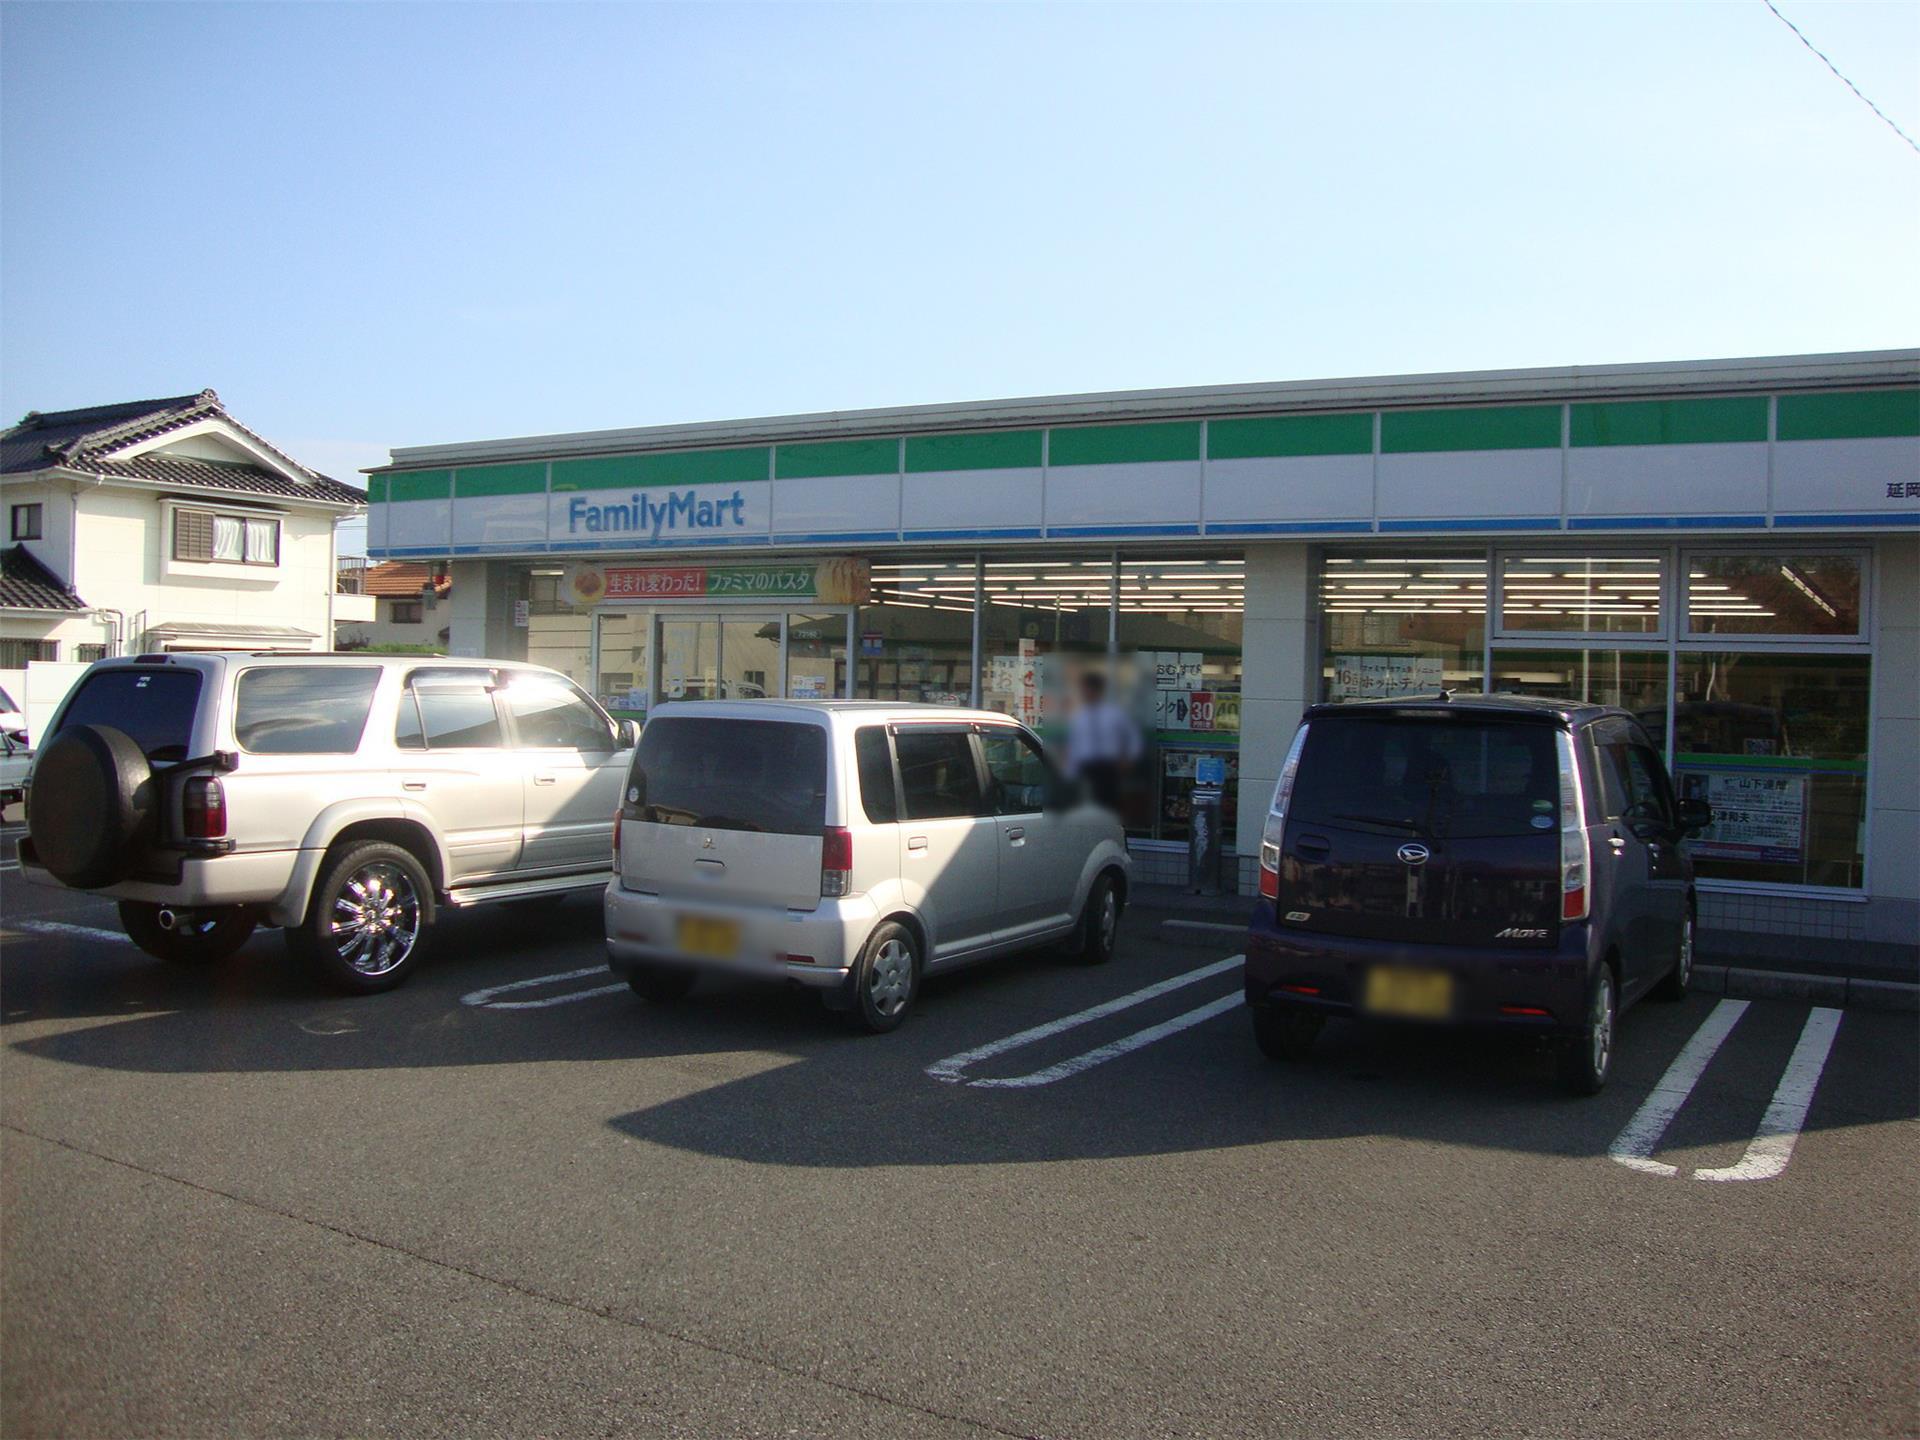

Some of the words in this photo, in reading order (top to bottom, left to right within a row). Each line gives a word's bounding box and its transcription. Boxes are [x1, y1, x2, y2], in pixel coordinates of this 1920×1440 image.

[1886, 482, 1920, 498] 延岡
[569, 489, 745, 543] FamilyMart
[710, 569, 809, 592] ファミマのパスタ
[1191, 702, 1214, 720] 30
[1495, 927, 1549, 938] MOVE
